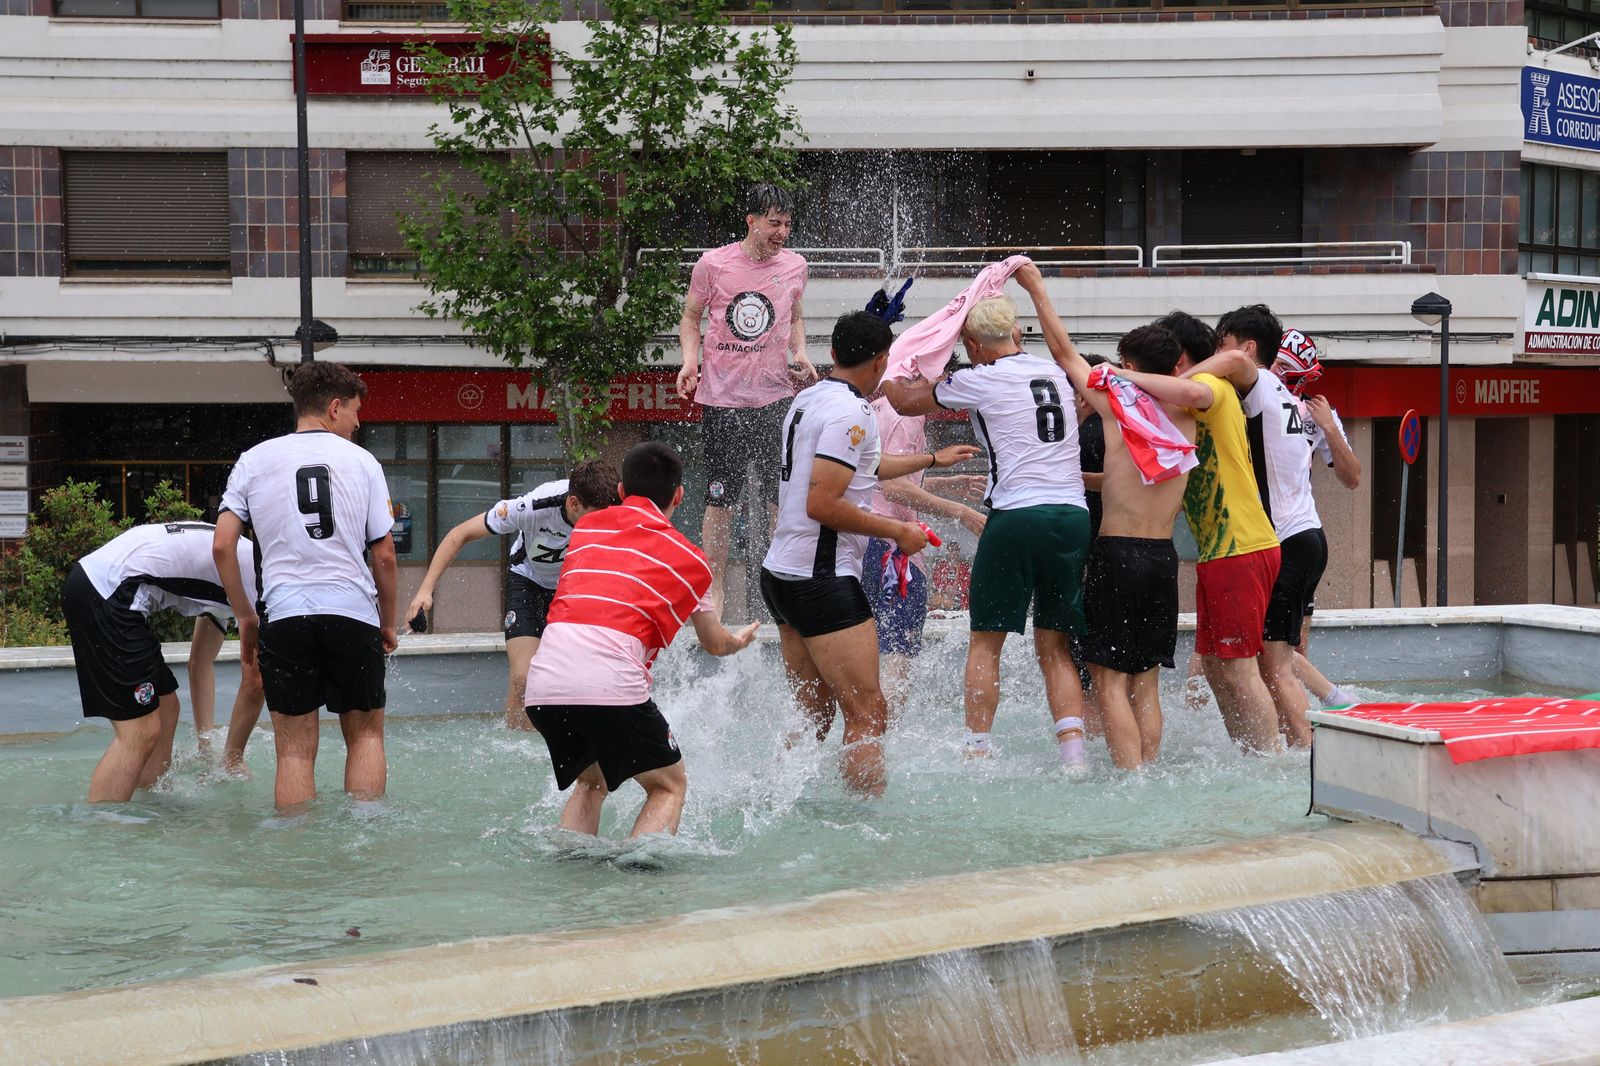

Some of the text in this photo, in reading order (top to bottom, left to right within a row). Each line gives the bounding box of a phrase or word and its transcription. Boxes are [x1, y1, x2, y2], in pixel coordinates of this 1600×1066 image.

[396, 56, 486, 73] GERALI
[396, 75, 429, 88] Segur
[1528, 334, 1583, 349] ADMINISTRACION
[1583, 335, 1592, 349] DE
[1475, 379, 1540, 404] MAPFRE
[1029, 378, 1066, 443] 8
[296, 464, 336, 540] 9
